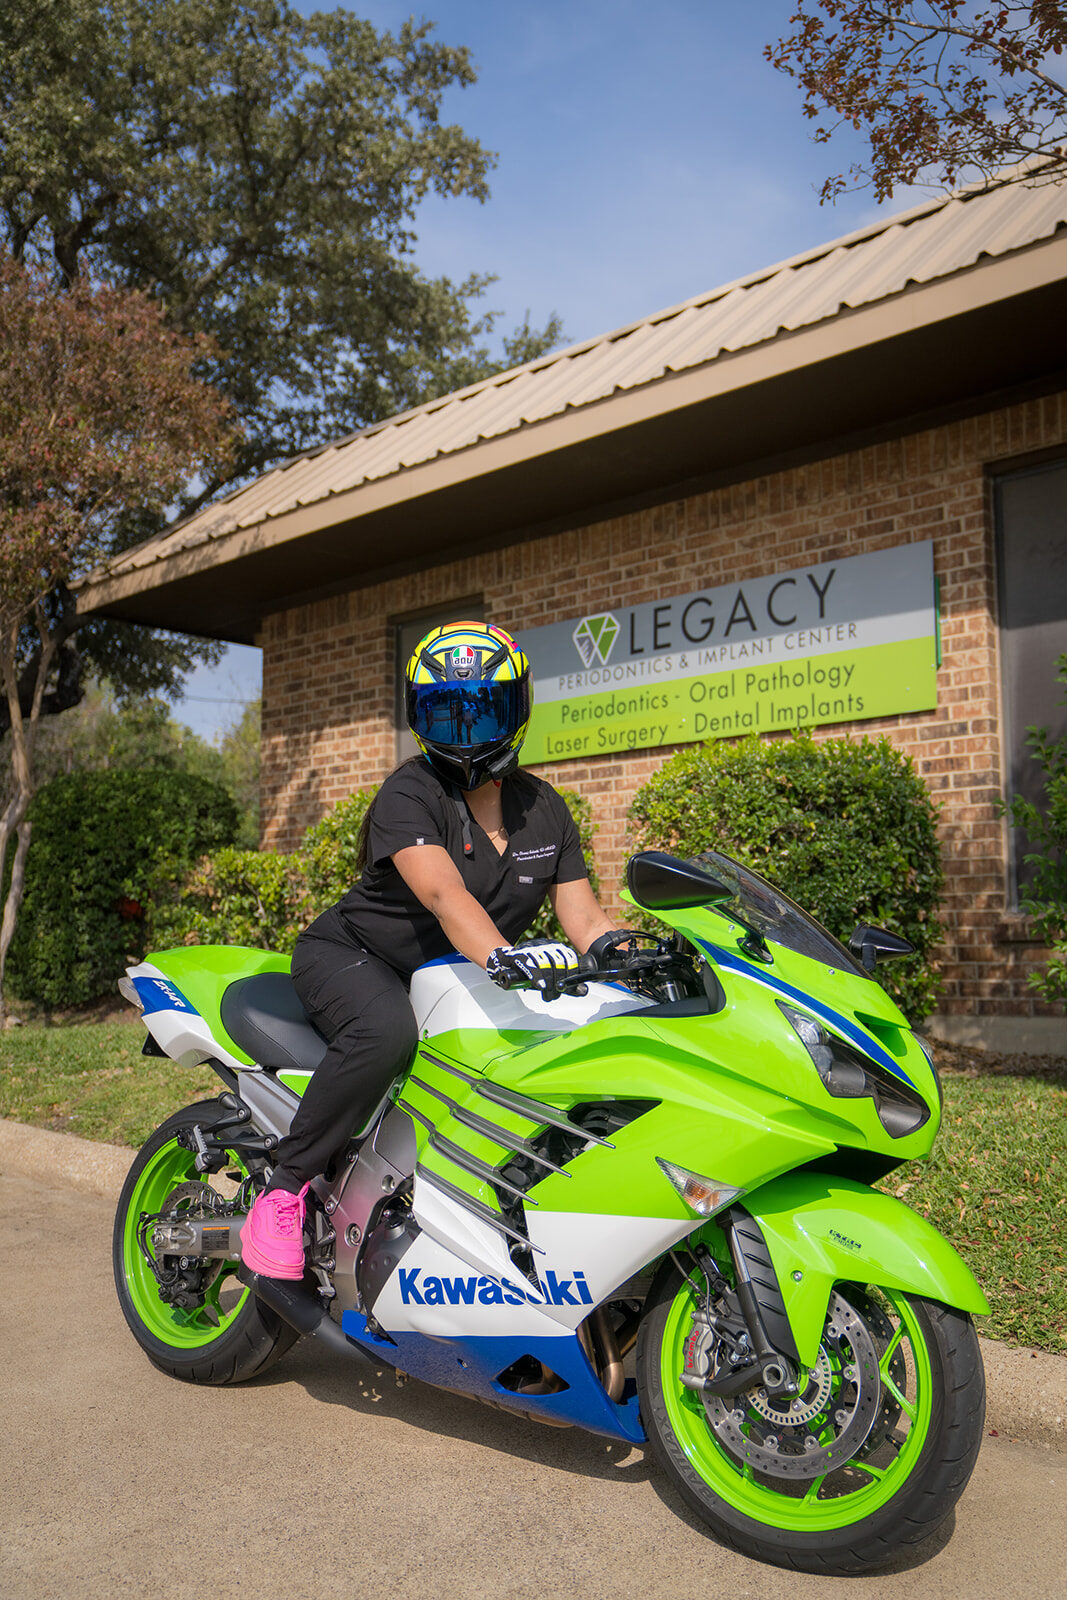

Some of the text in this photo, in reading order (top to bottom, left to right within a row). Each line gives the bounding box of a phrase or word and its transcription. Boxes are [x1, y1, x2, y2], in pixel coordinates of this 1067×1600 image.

[629, 568, 837, 656] LEGACY
[558, 622, 858, 691] PERIODONTICS & IMPLANT CENTER
[546, 735, 590, 756] Laser
[597, 724, 669, 751] Surgery
[694, 701, 760, 735] Dental
[770, 692, 865, 728] Implants
[561, 690, 669, 725] Periodontics
[689, 672, 736, 704] Oral
[745, 660, 856, 695] Pathology
[686, 1329, 700, 1369] brembo
